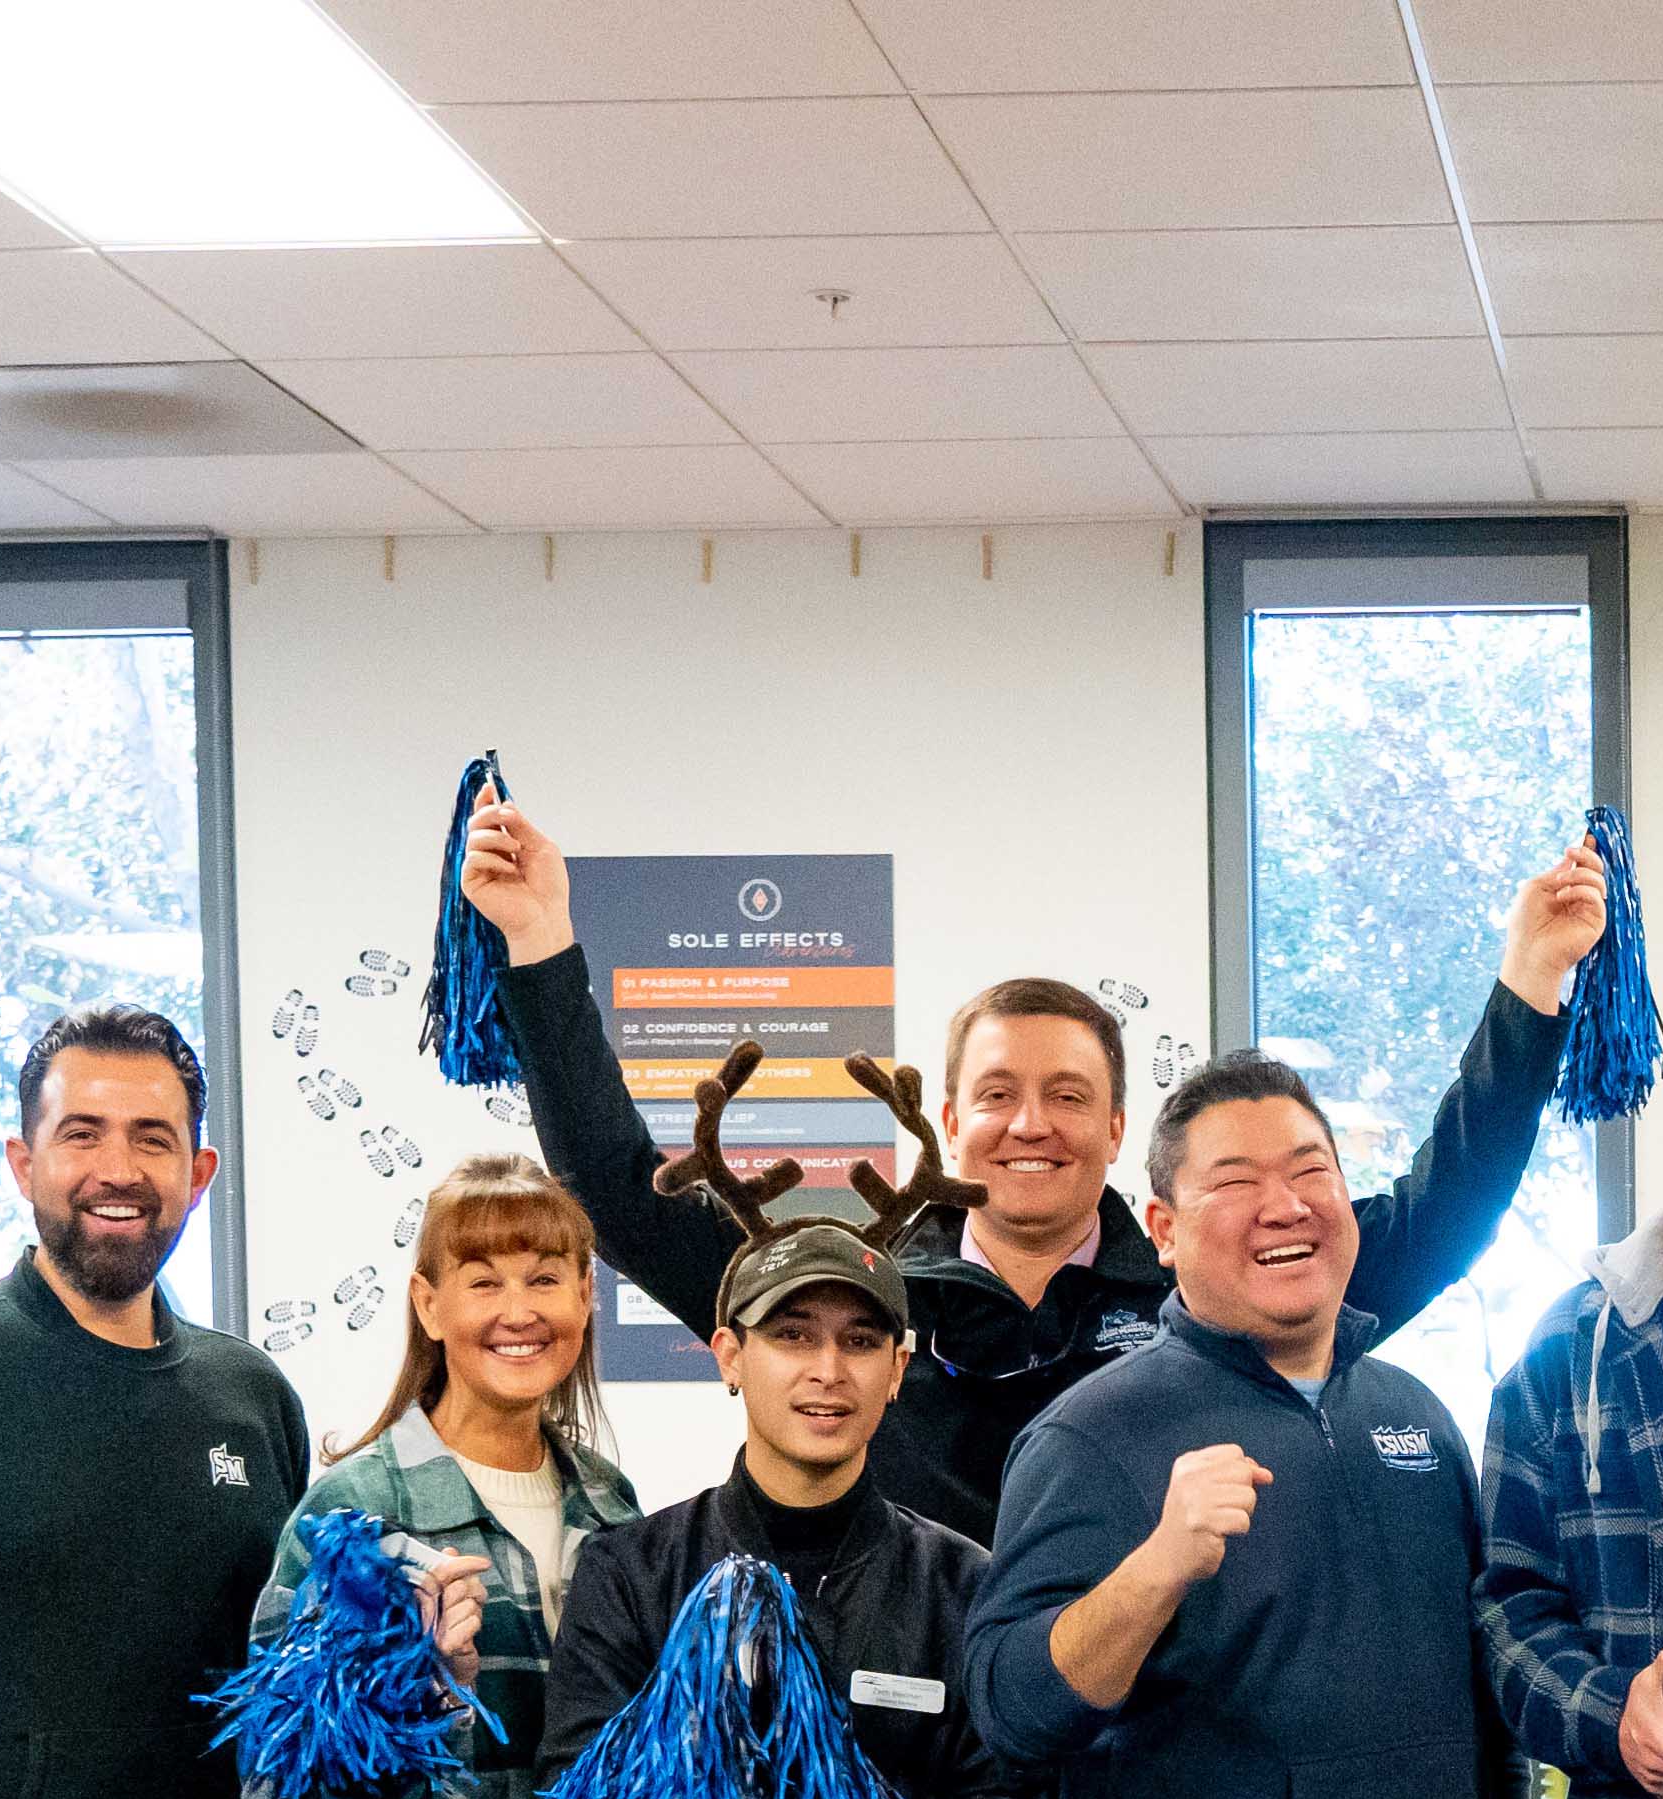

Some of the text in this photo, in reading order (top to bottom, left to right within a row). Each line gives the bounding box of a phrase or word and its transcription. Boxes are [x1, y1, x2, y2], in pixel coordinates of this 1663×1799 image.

[668, 932, 844, 949] SOLE EFFECTS
[622, 977, 790, 989] 01 PASSION & PURPOSE
[622, 1022, 829, 1034] 02 CONFIDENCE & COURAGE
[624, 1069, 641, 1079] 03
[647, 1113, 692, 1124] STRES
[1372, 1431, 1434, 1455] CSUSM
